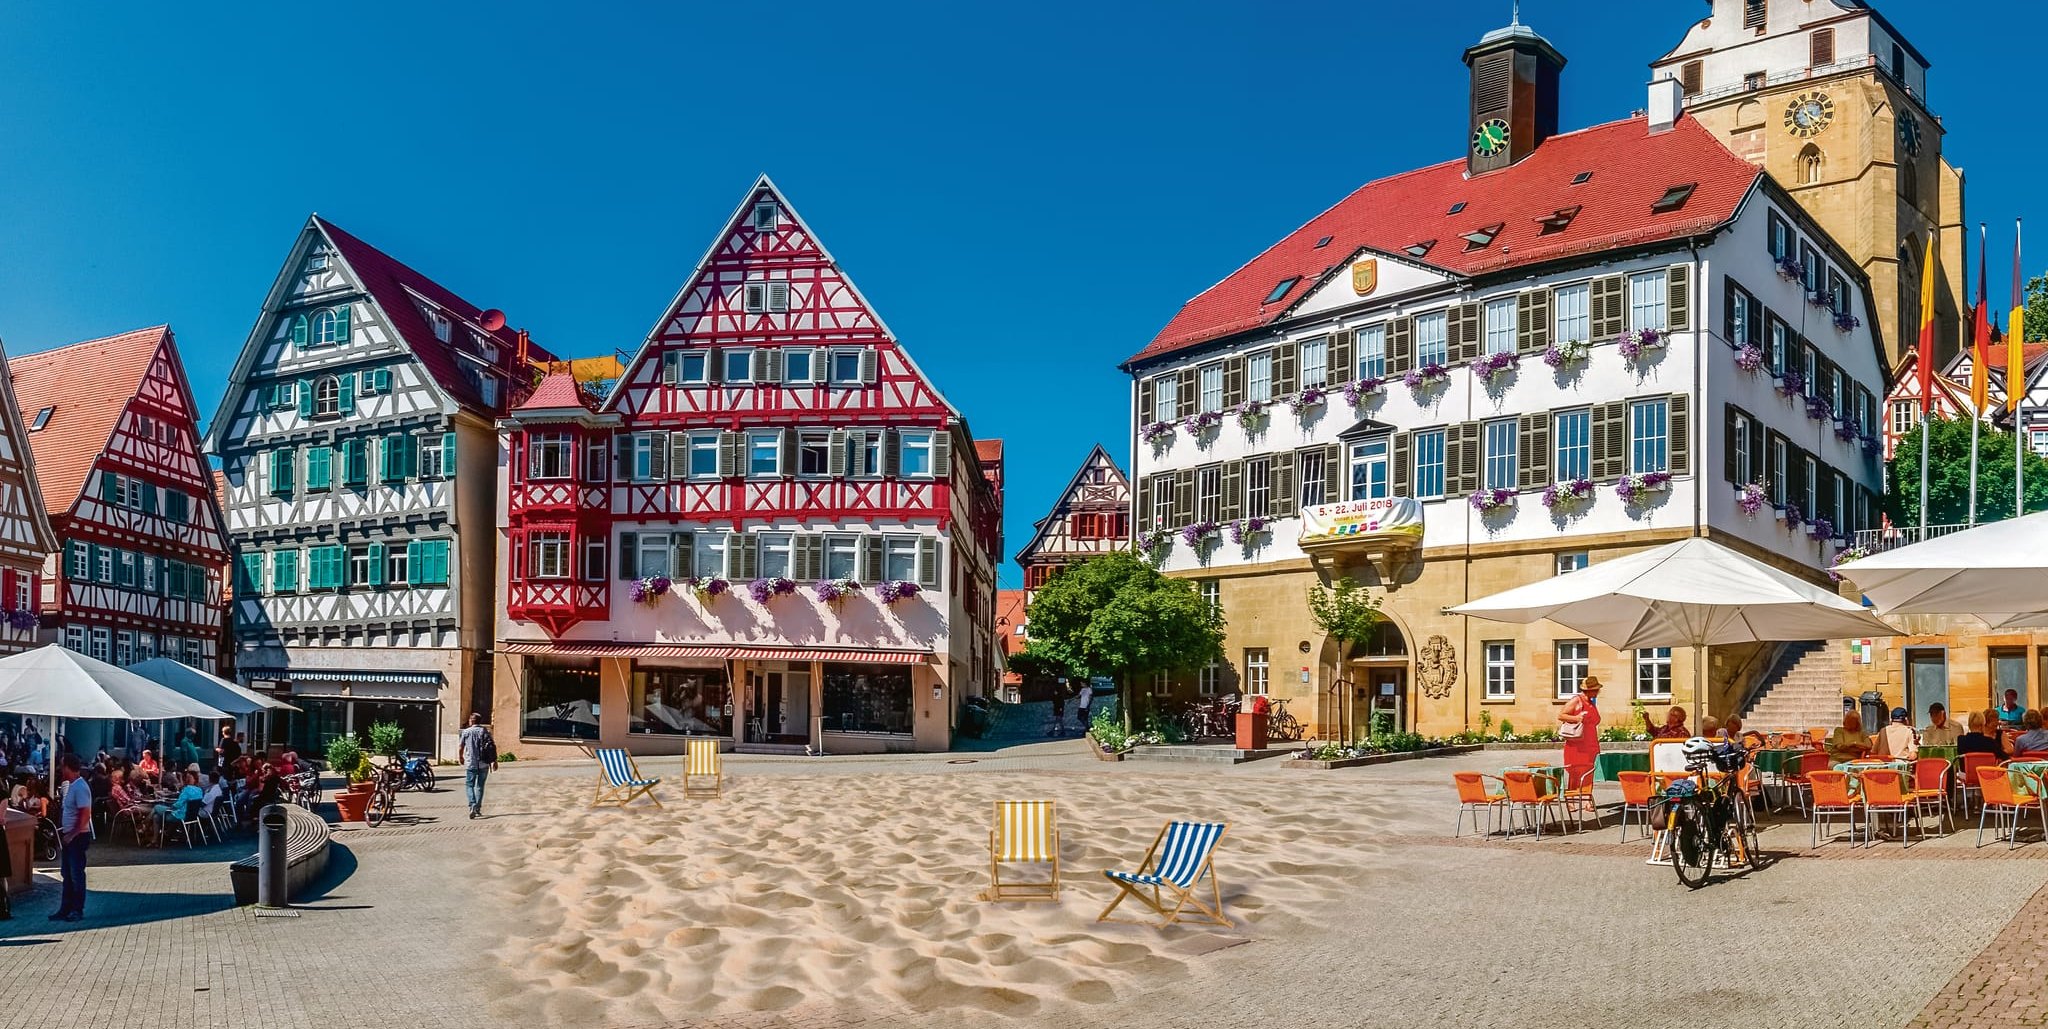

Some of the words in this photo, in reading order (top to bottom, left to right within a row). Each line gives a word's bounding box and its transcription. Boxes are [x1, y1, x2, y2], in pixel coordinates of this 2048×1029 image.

[1320, 508, 1328, 516] 5.
[1336, 506, 1349, 514] 22.
[1352, 502, 1367, 512] Juli
[1370, 500, 1392, 510] 2018
